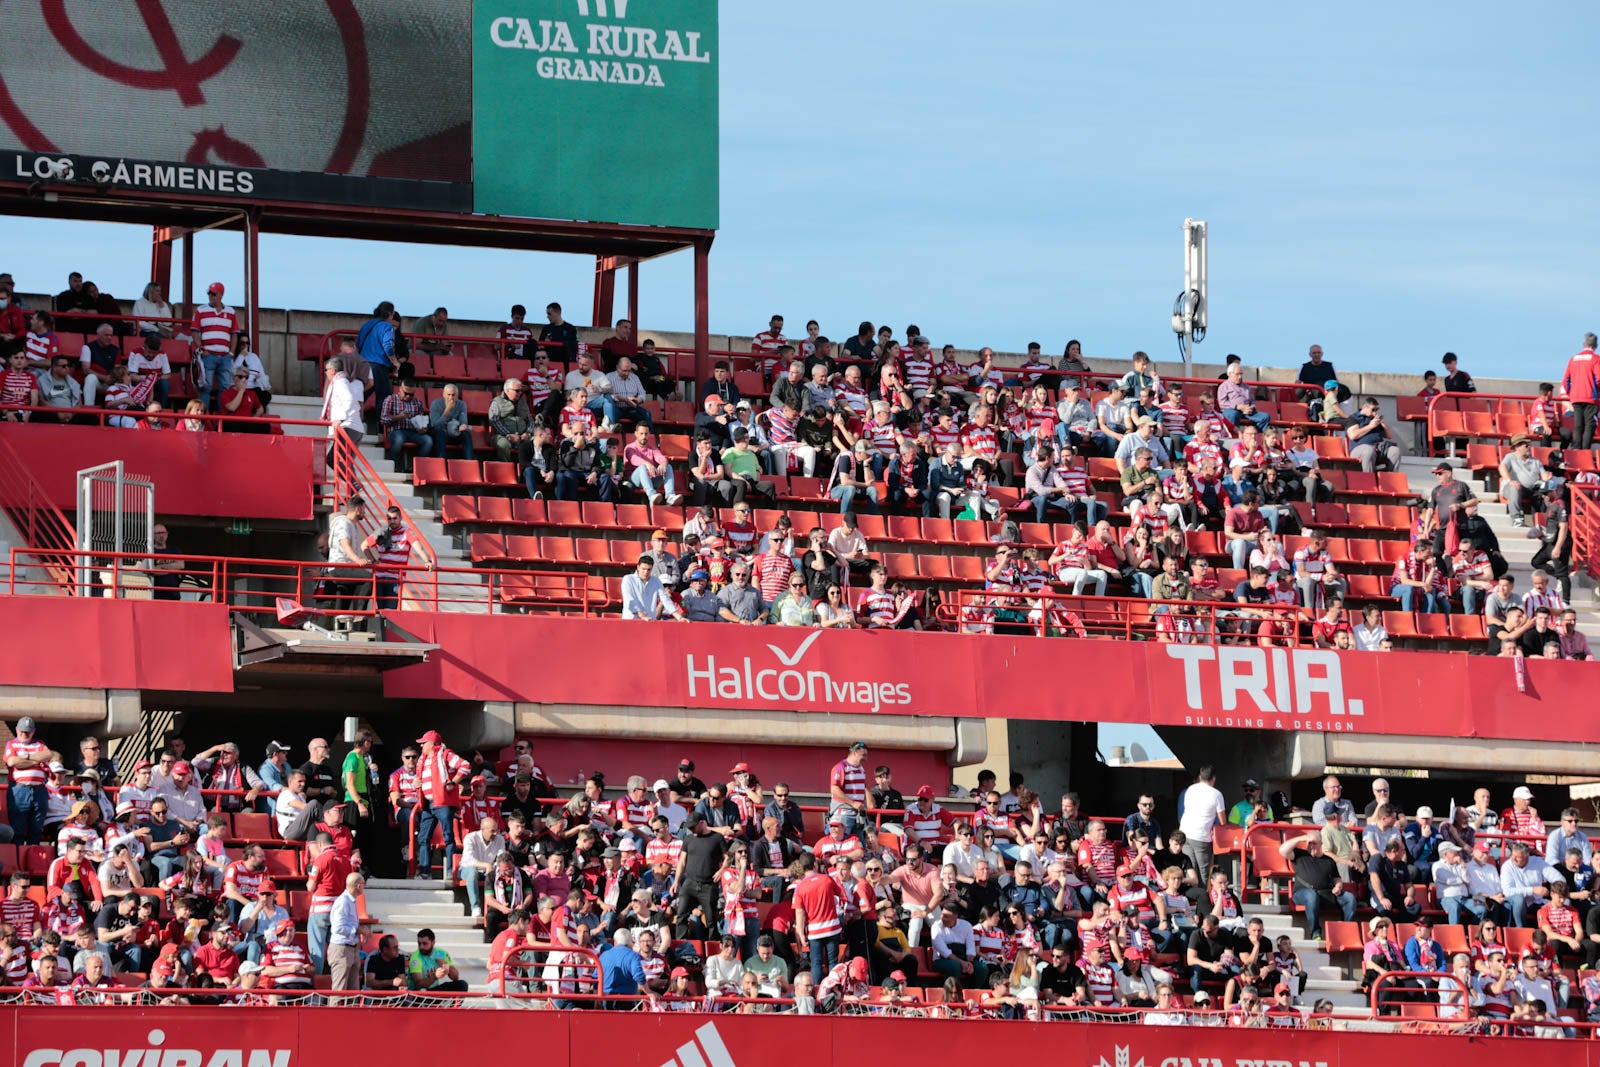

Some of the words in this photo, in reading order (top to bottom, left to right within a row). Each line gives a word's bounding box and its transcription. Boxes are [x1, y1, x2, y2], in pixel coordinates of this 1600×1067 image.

[490, 16, 579, 53] CAJA
[586, 24, 710, 63] RURAL
[536, 57, 665, 87] GRANADA
[1166, 644, 1364, 715] TRIA.
[1185, 716, 1264, 727] BUILDING
[1275, 720, 1283, 729] &
[1294, 721, 1354, 731] DESIGN
